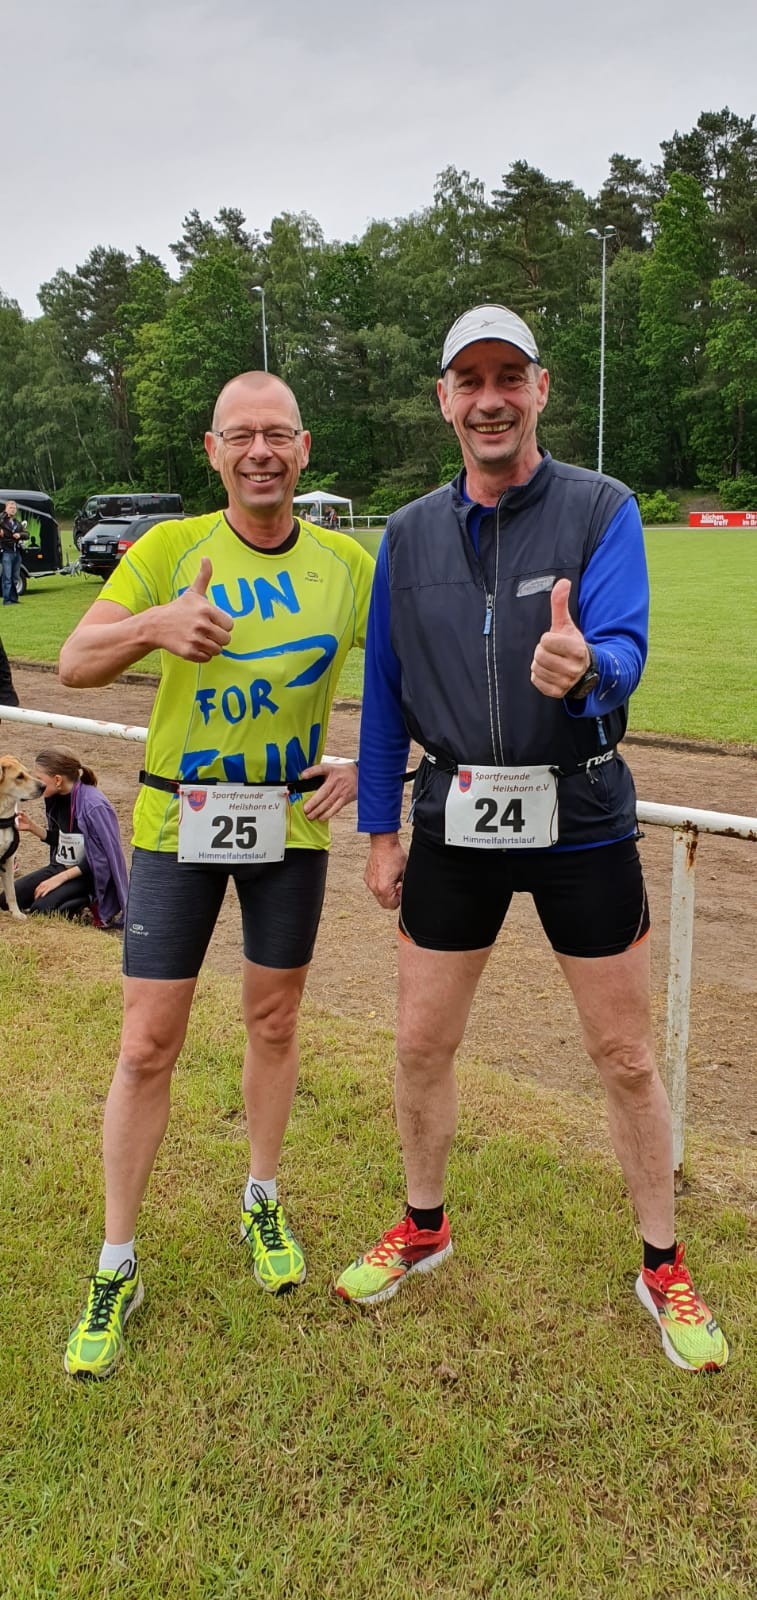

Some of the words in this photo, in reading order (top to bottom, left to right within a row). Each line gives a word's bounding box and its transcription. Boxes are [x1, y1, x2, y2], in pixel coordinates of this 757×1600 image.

[178, 570, 301, 622] UN
[194, 678, 280, 726] FOR
[475, 772, 530, 782] Sportfreunde
[492, 784, 534, 793] Heilshorn
[211, 791, 264, 801] Sportfreunde
[228, 803, 267, 811] Heilshorn
[474, 797, 526, 833] 24
[210, 815, 258, 850] 25
[463, 835, 536, 845] Himmelfahrtslauf
[58, 845, 76, 860] 41
[198, 851, 267, 860] Himmelfahrtslauf
